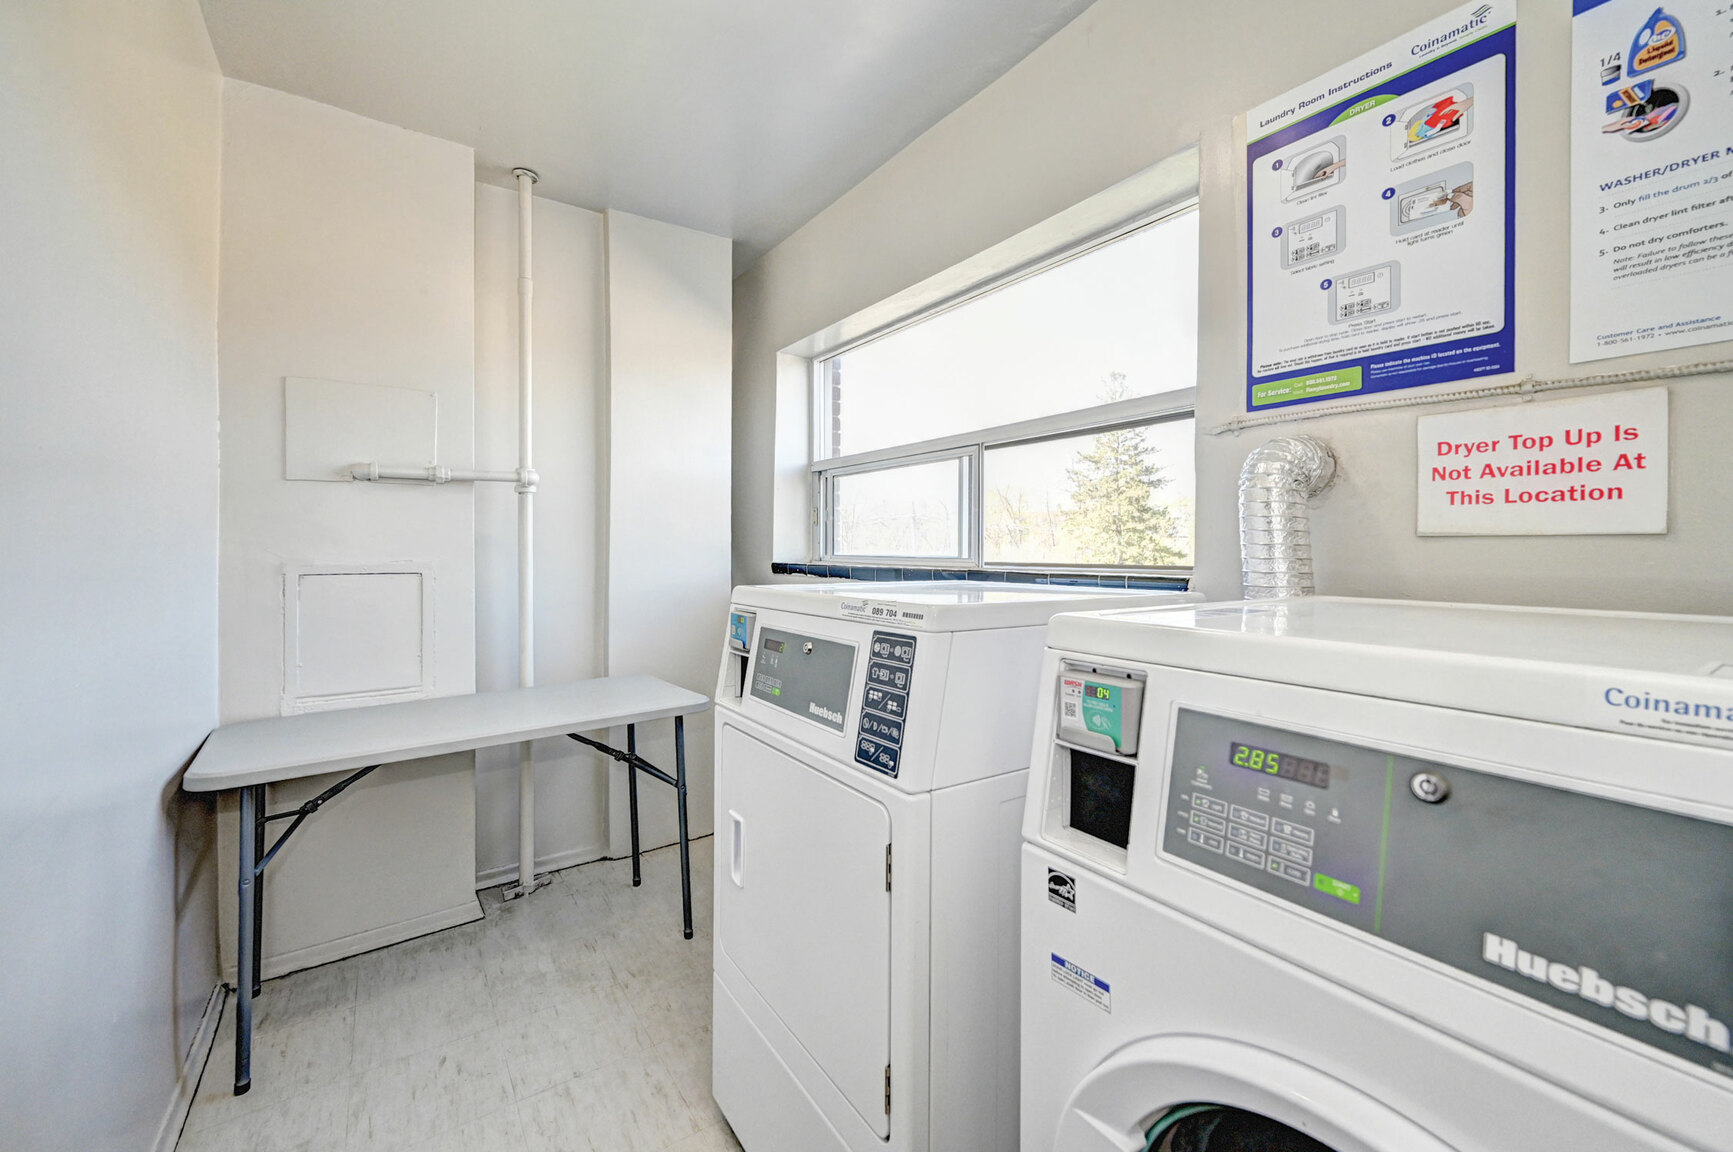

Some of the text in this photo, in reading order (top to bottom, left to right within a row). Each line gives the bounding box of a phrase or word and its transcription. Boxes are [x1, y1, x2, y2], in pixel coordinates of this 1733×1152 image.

[1411, 15, 1487, 56] Coinamatic
[1600, 51, 1621, 67] 1/4
[1259, 61, 1393, 128] Laundry Room Instructions
[1349, 99, 1376, 116] DRYER
[1599, 150, 1721, 192] WASHER/DRYER
[1613, 199, 1636, 209] Only
[1638, 194, 1651, 202] fill
[1653, 189, 1670, 198] the
[1672, 181, 1700, 193] drum
[1703, 176, 1719, 185] 2/3
[1720, 170, 1733, 179] of
[1613, 221, 1640, 231] Clean
[1642, 213, 1669, 224] dryer
[1671, 208, 1689, 217] lint
[1691, 200, 1717, 211] filter
[1613, 245, 1627, 253] Do
[1629, 240, 1646, 249] not
[1647, 235, 1664, 244] dry
[1666, 221, 1728, 239] comforters.
[1637, 248, 1666, 259] Failure
[1678, 239, 1707, 251] follow
[1613, 264, 1628, 273] will
[1629, 259, 1653, 269] result
[1664, 253, 1680, 261] low
[1682, 245, 1725, 259] efficiency
[1613, 266, 1659, 281] overloaded
[1660, 260, 1686, 271] dryers
[1688, 257, 1705, 265] can
[1597, 315, 1721, 341] Customer Care and Assistance
[1267, 387, 1292, 397] Service:
[1436, 424, 1640, 458] Dryer Top Up Is
[1431, 452, 1647, 482] Not Available At
[1446, 484, 1624, 506] This Location
[840, 601, 867, 613] Coinamatic
[872, 607, 898, 618] 089 704
[1096, 687, 1110, 700] 04
[809, 701, 843, 725] Huebsch
[1233, 746, 1280, 775] 2.85
[1064, 959, 1096, 985] NOTICE
[1483, 931, 1731, 1052] Huebsch
